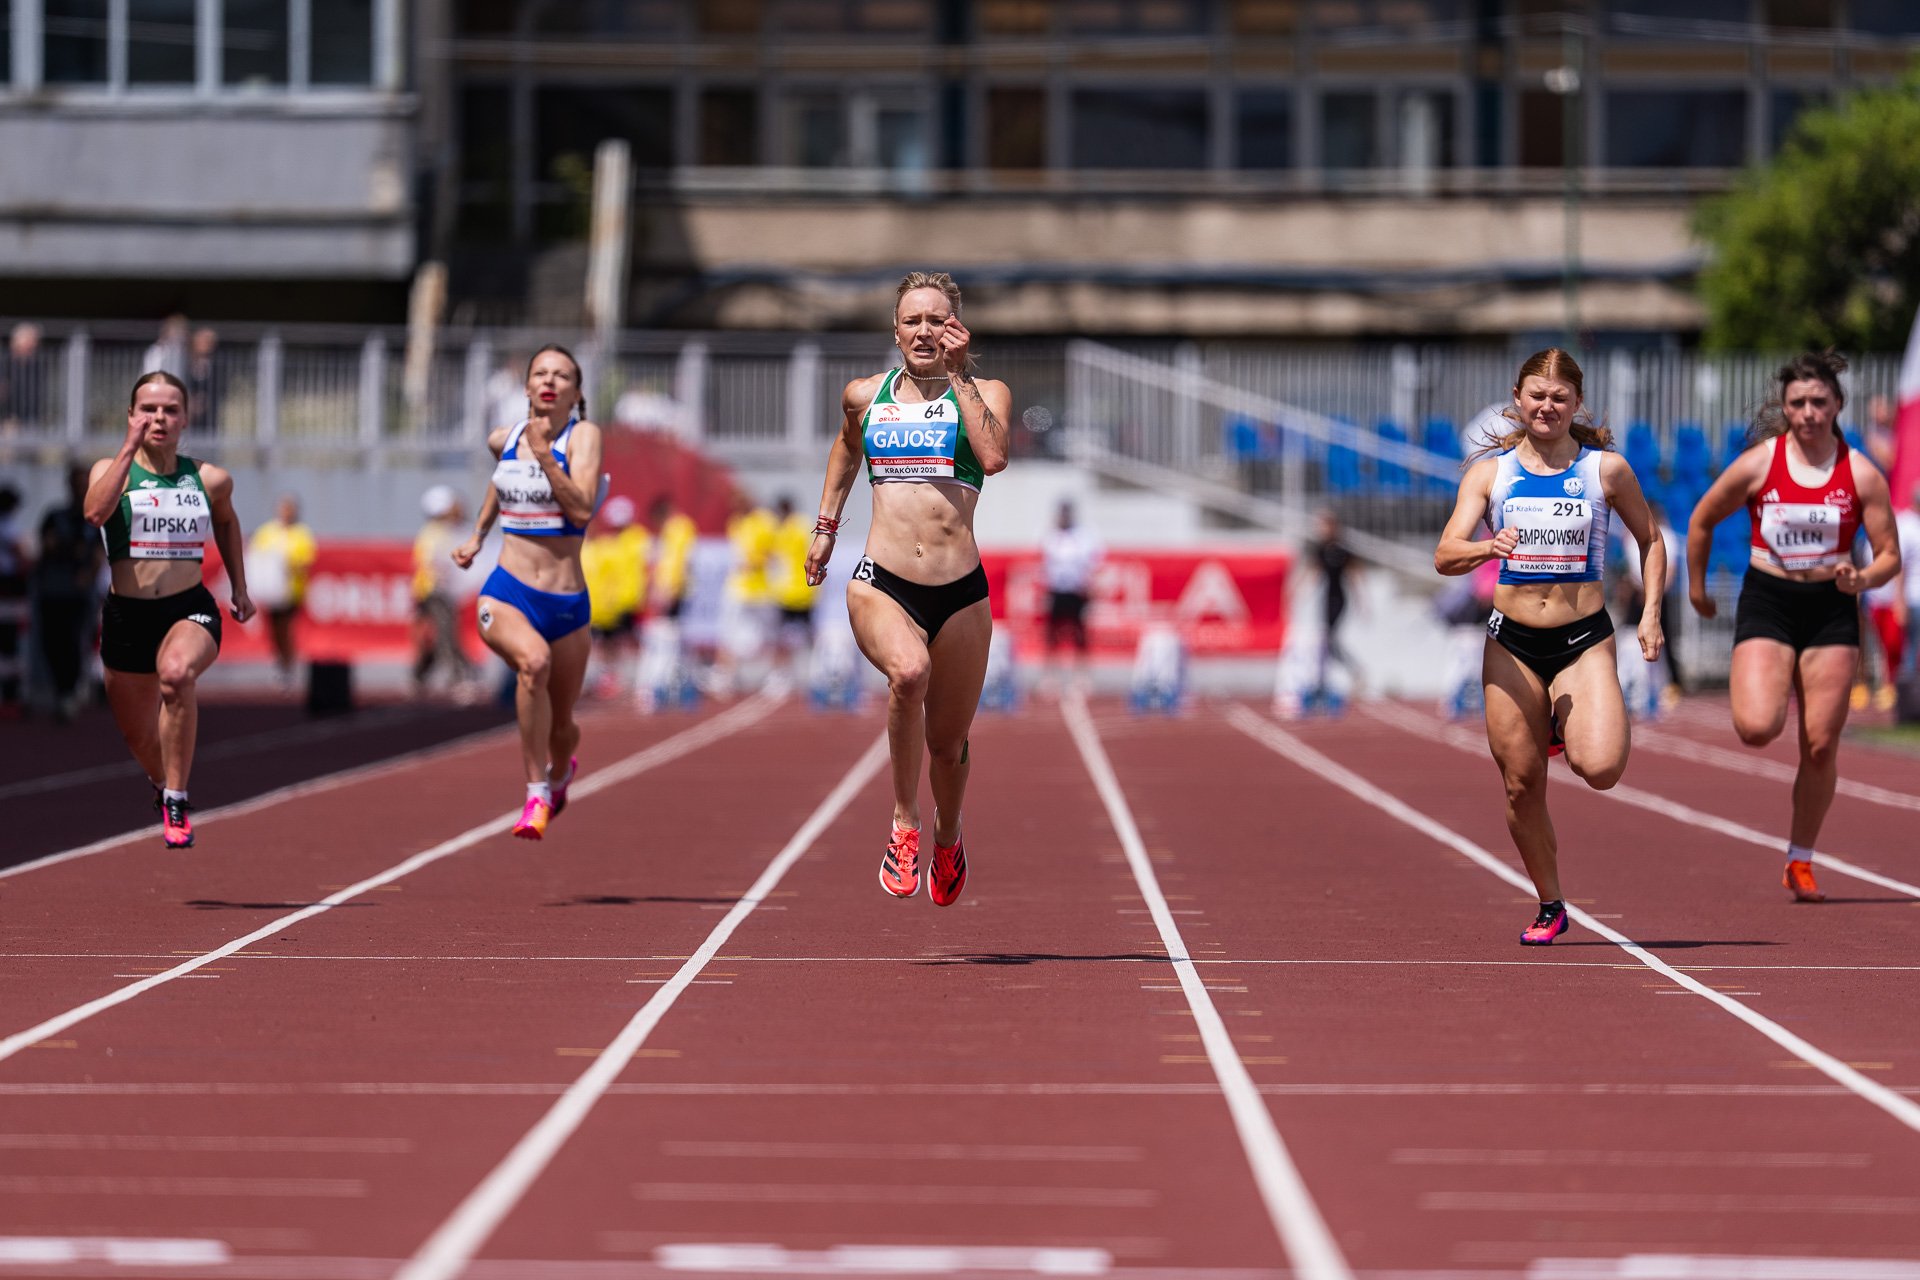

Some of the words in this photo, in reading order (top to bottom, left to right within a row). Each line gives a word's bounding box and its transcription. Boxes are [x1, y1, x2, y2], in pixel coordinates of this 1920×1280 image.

[924, 403, 945, 419] 64
[873, 430, 948, 448] GAJOSZ
[884, 465, 919, 474] KRAKÓW
[920, 466, 937, 474] 2026
[175, 493, 200, 507] 148
[1553, 502, 1584, 517] 291
[1809, 508, 1827, 524] 82
[143, 517, 198, 533] LIPSKA
[1517, 528, 1585, 546] EMPKOWSKA
[858, 561, 871, 580] 5
[1520, 563, 1554, 571] KRAKÓW
